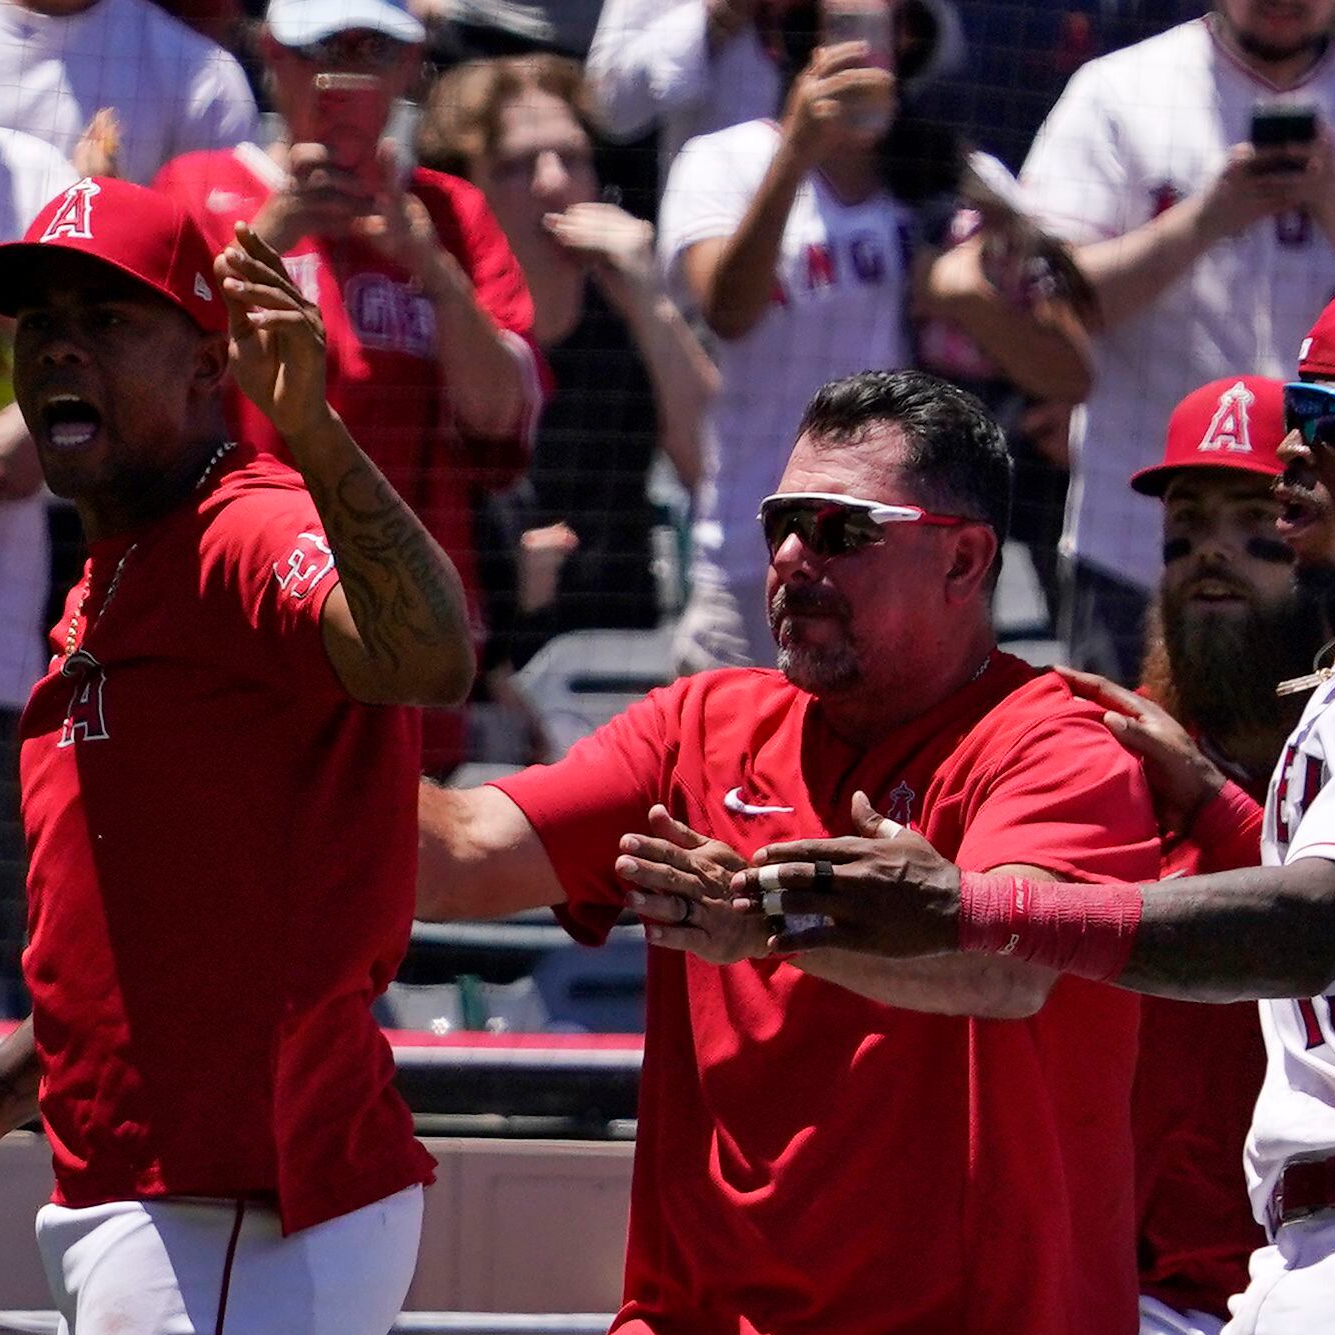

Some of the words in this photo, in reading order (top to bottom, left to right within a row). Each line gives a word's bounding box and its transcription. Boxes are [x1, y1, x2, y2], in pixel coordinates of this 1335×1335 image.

[40, 177, 101, 243] A
[1197, 381, 1255, 452] A
[58, 650, 109, 747] A
